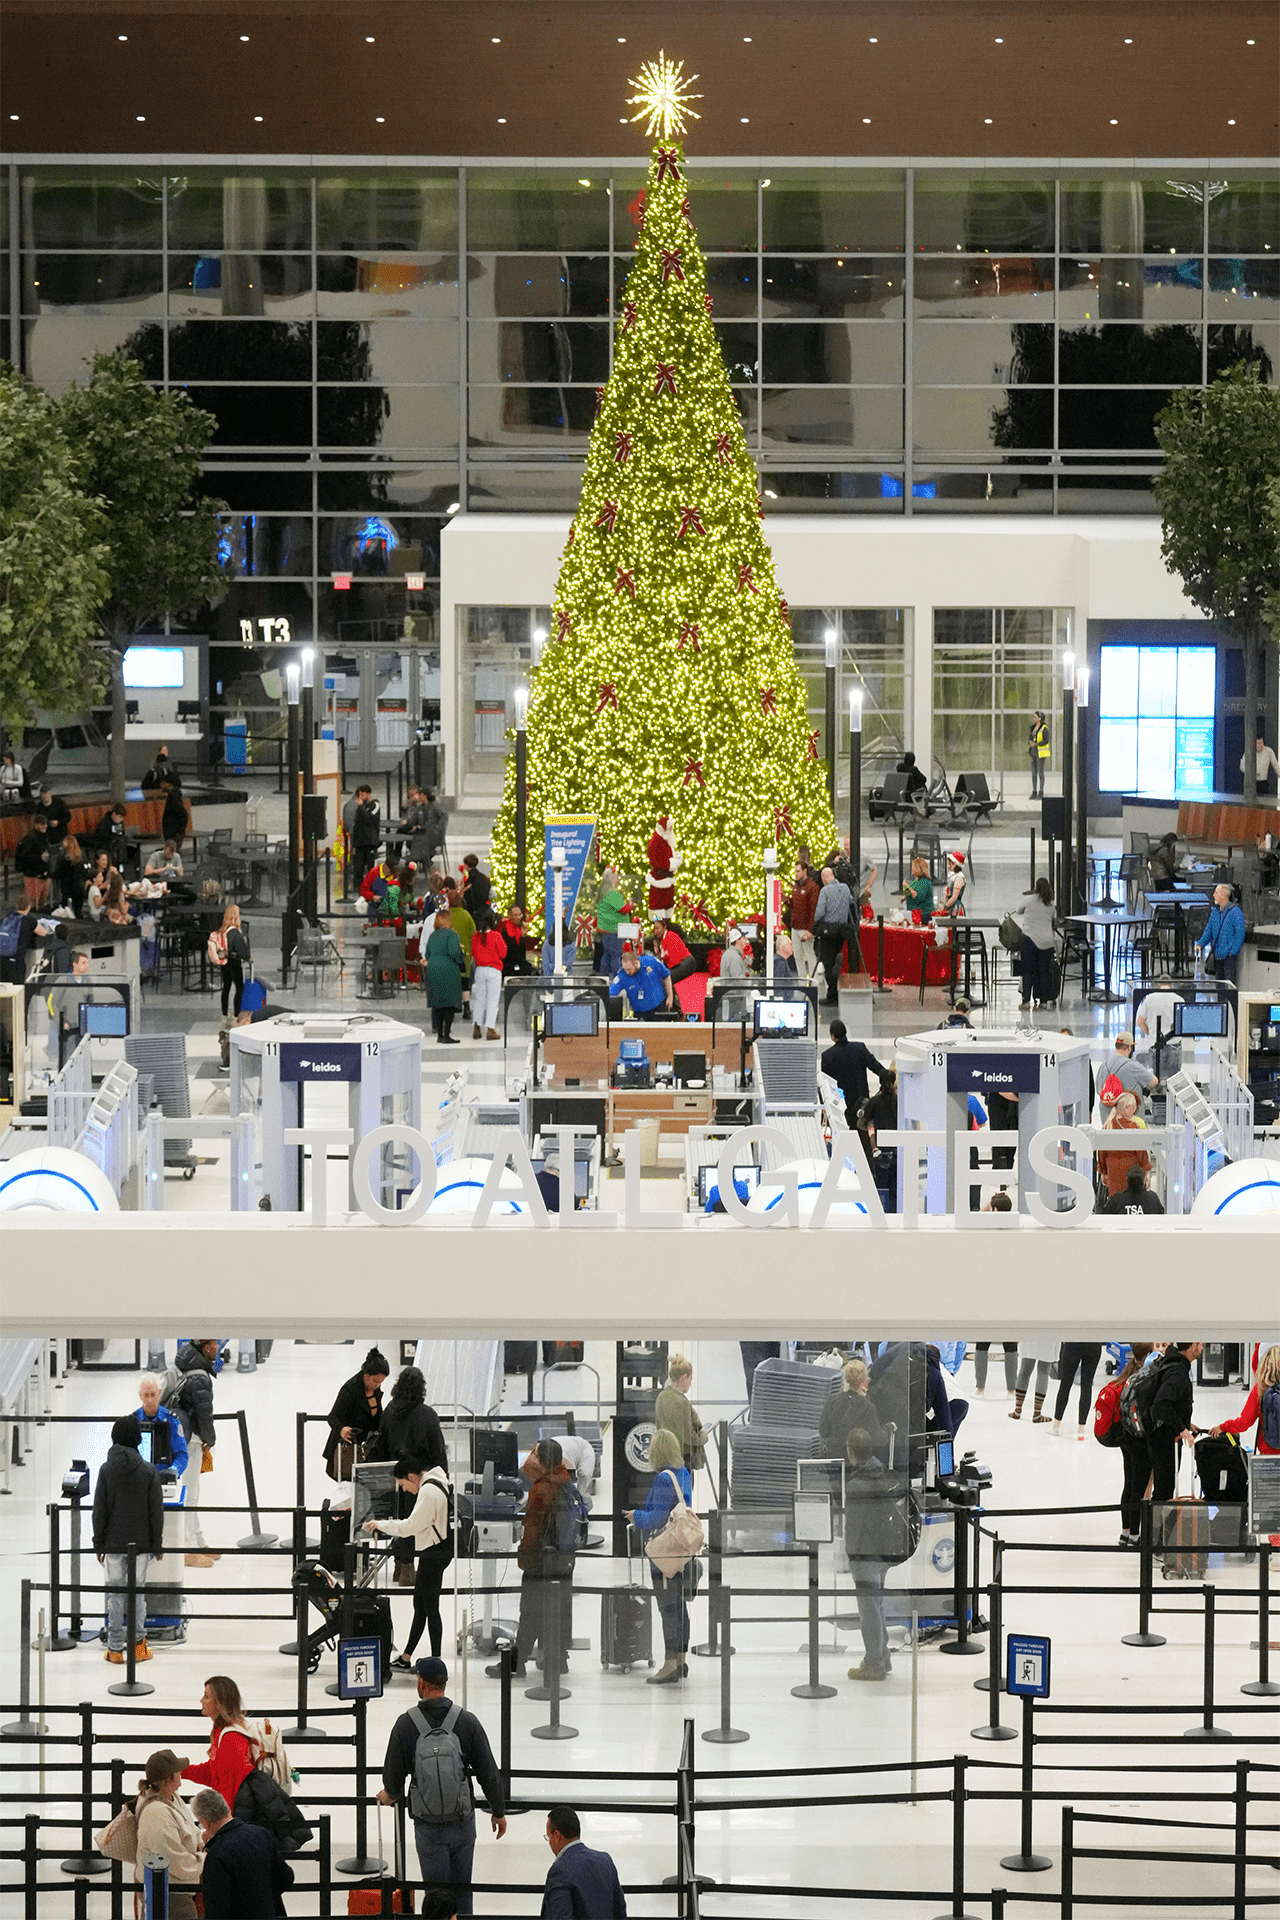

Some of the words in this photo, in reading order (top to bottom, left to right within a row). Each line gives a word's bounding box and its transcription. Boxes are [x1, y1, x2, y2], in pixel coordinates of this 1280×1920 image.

[258, 617, 291, 643] T3
[1223, 703, 1268, 712] DIRECRY
[550, 830, 578, 839] Inaugural
[551, 839, 563, 847] Tree
[563, 839, 586, 847] Lighting
[266, 1043, 277, 1056] 11
[367, 1043, 378, 1056] 12
[931, 1053, 944, 1066] 13
[1044, 1054, 1056, 1067] 14
[312, 1062, 341, 1072] leidos
[983, 1072, 1014, 1083] leidos
[284, 1124, 438, 1227] TO
[471, 1128, 683, 1228] ALL
[717, 1124, 1096, 1229] GATES
[1125, 1204, 1144, 1215] TSA
